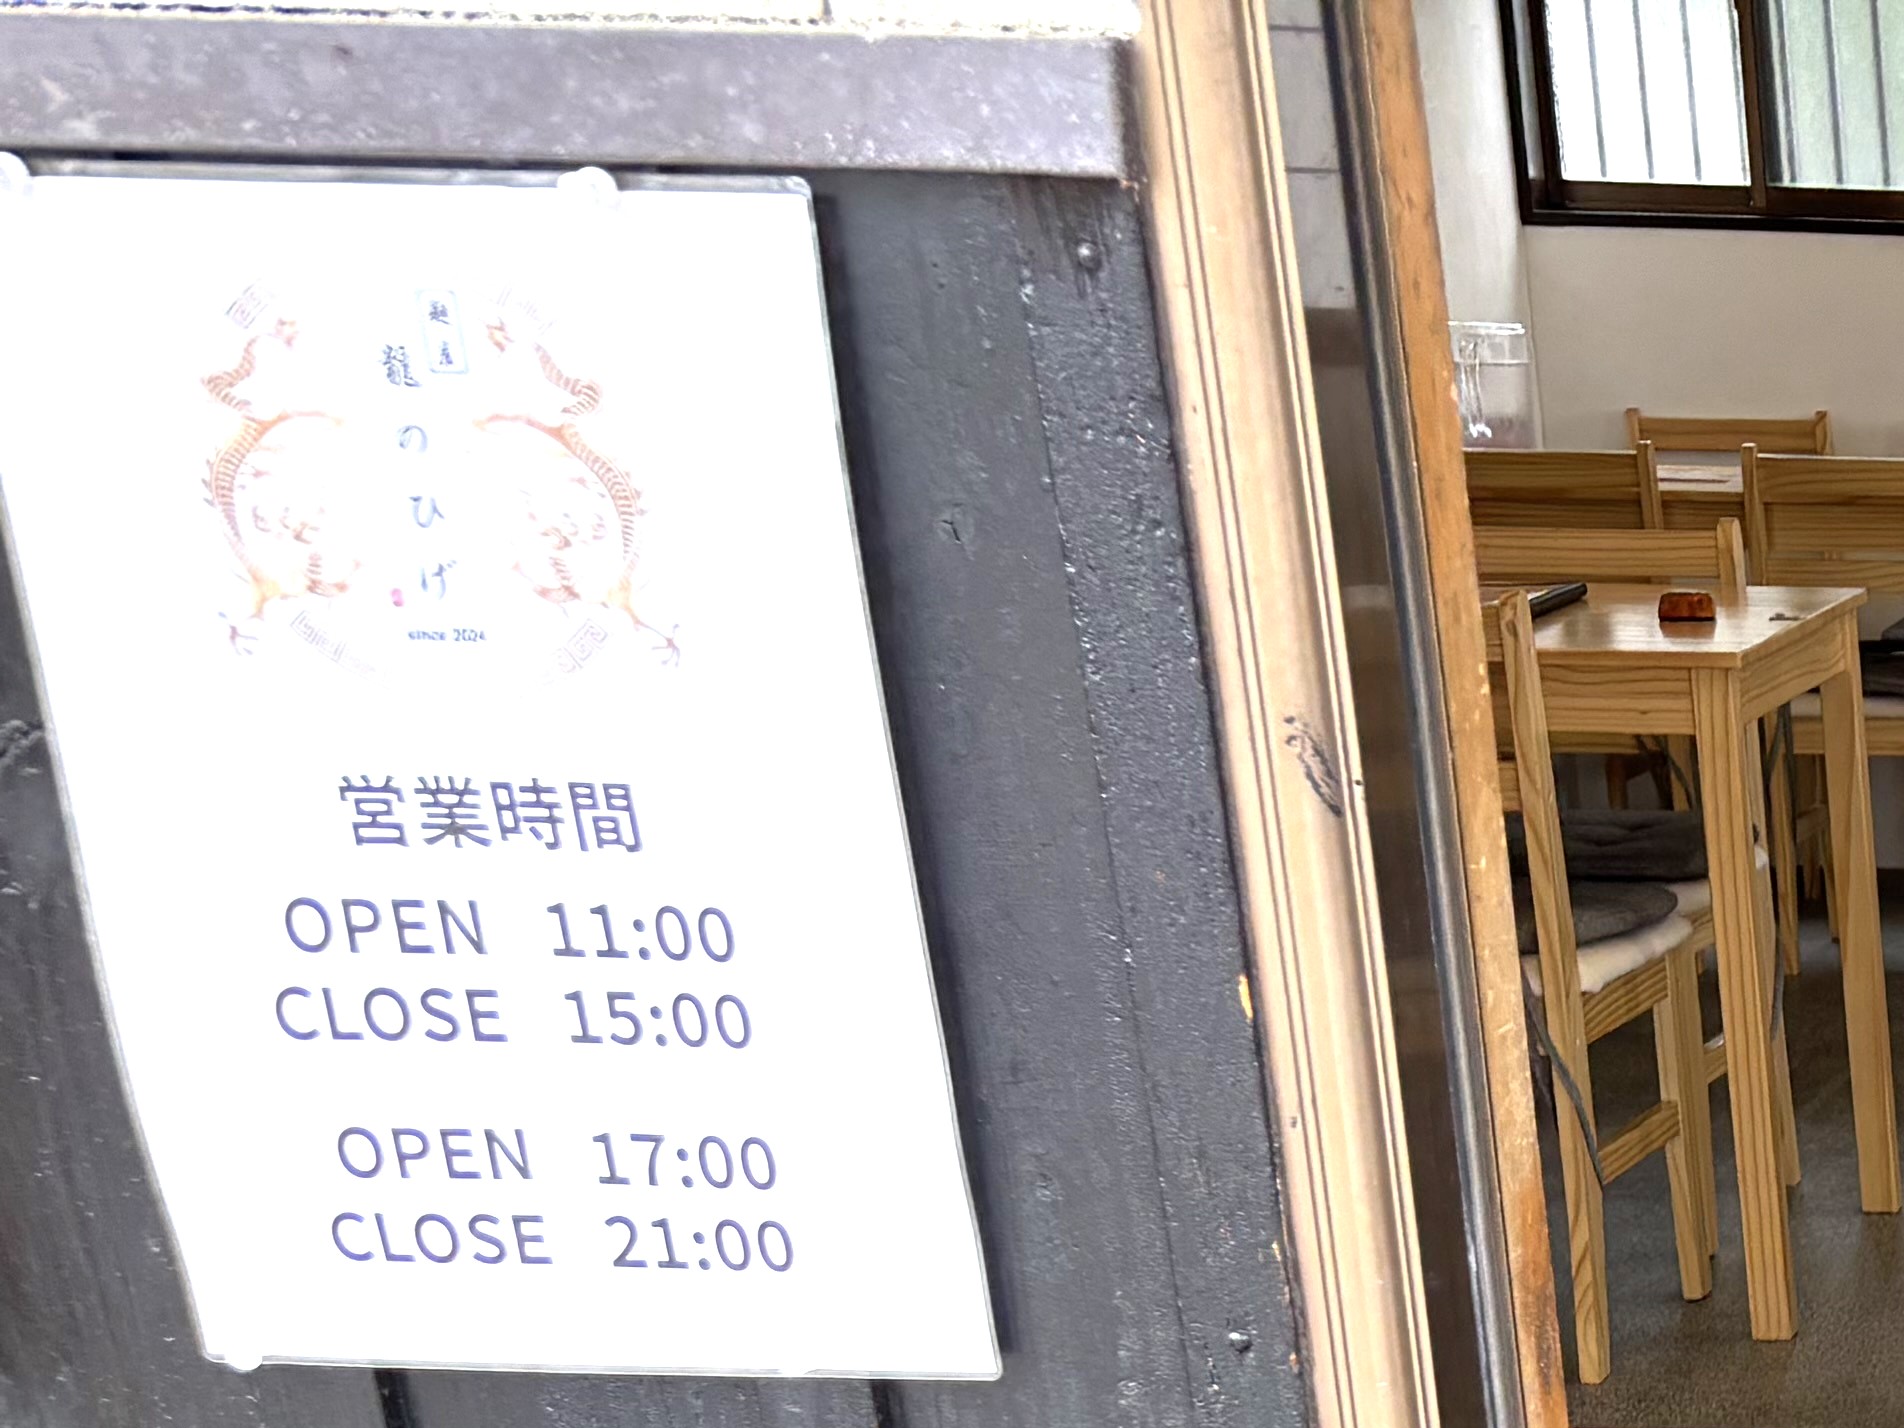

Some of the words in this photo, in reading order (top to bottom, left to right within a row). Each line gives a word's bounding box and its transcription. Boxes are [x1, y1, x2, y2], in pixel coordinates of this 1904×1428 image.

[337, 774, 644, 854] 営業時間
[284, 896, 488, 956] OPEN
[546, 902, 735, 964] 11:00
[275, 986, 508, 1043] CLOSE
[564, 990, 752, 1050] 15:00
[337, 1126, 532, 1181] OPEN
[592, 1132, 777, 1192] 17:00
[331, 1212, 553, 1266] CLOSE
[604, 1215, 794, 1273] 21:00
